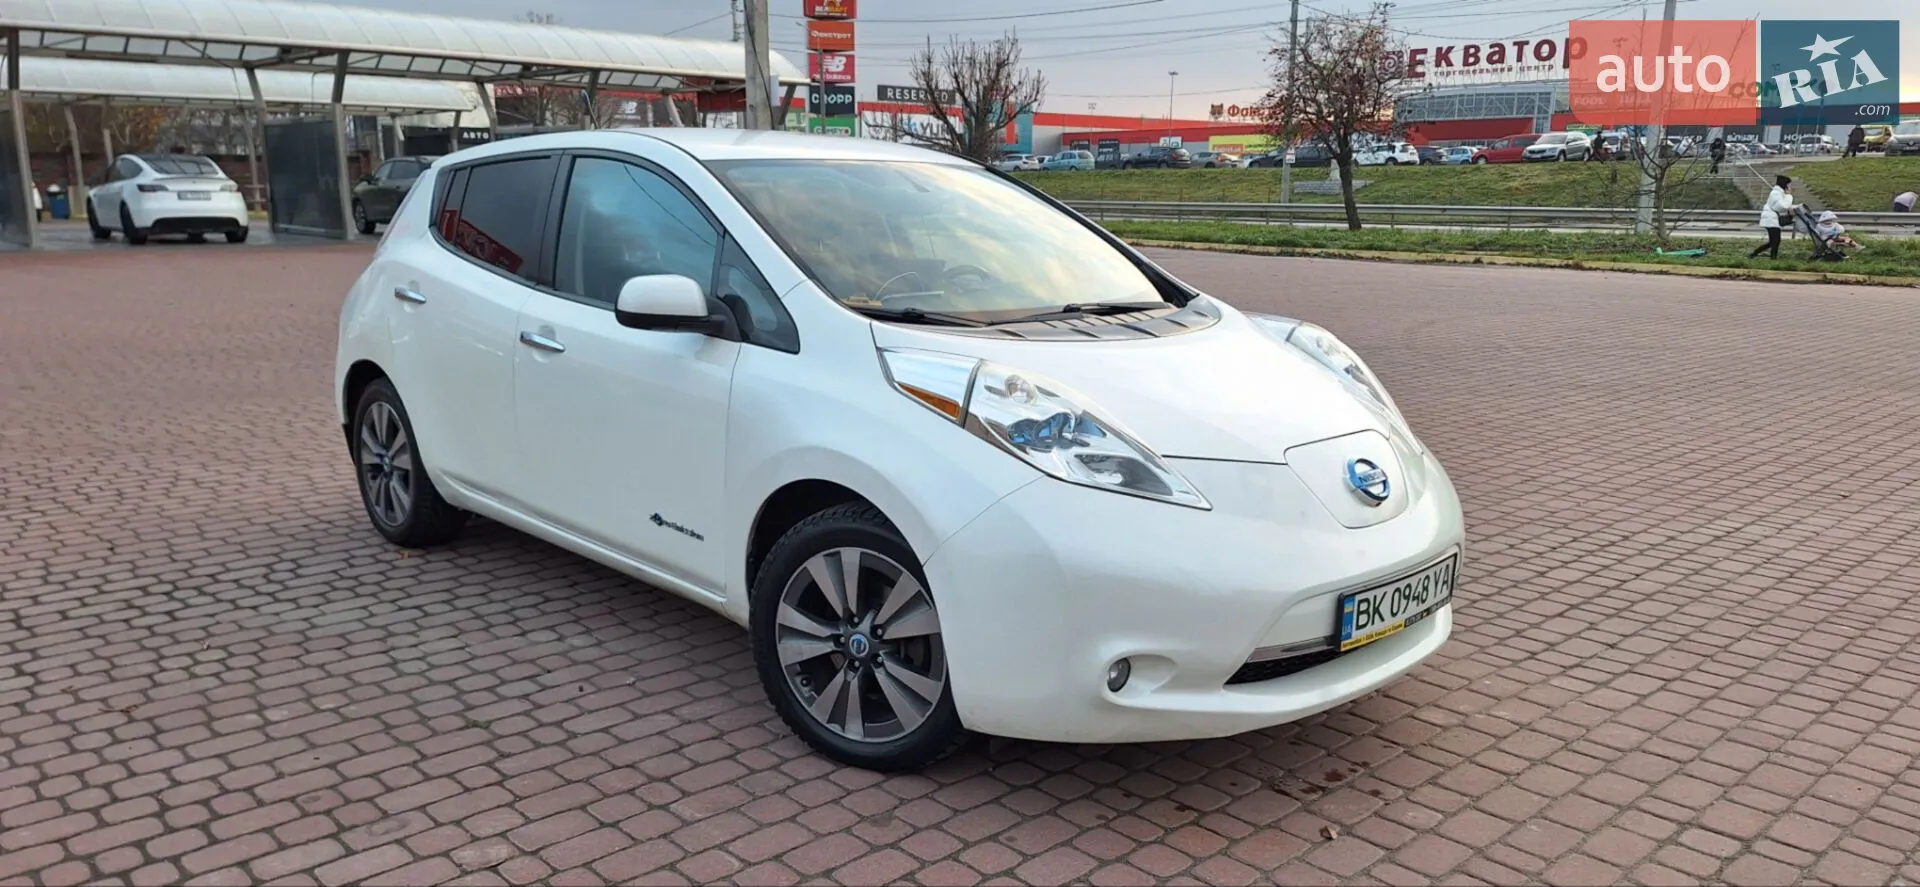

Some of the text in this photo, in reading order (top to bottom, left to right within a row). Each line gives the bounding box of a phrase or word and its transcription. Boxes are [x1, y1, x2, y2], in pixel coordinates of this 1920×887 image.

[1355, 590, 1388, 631] BK
[1390, 574, 1431, 618] 0948
[1433, 563, 1450, 598] YA
